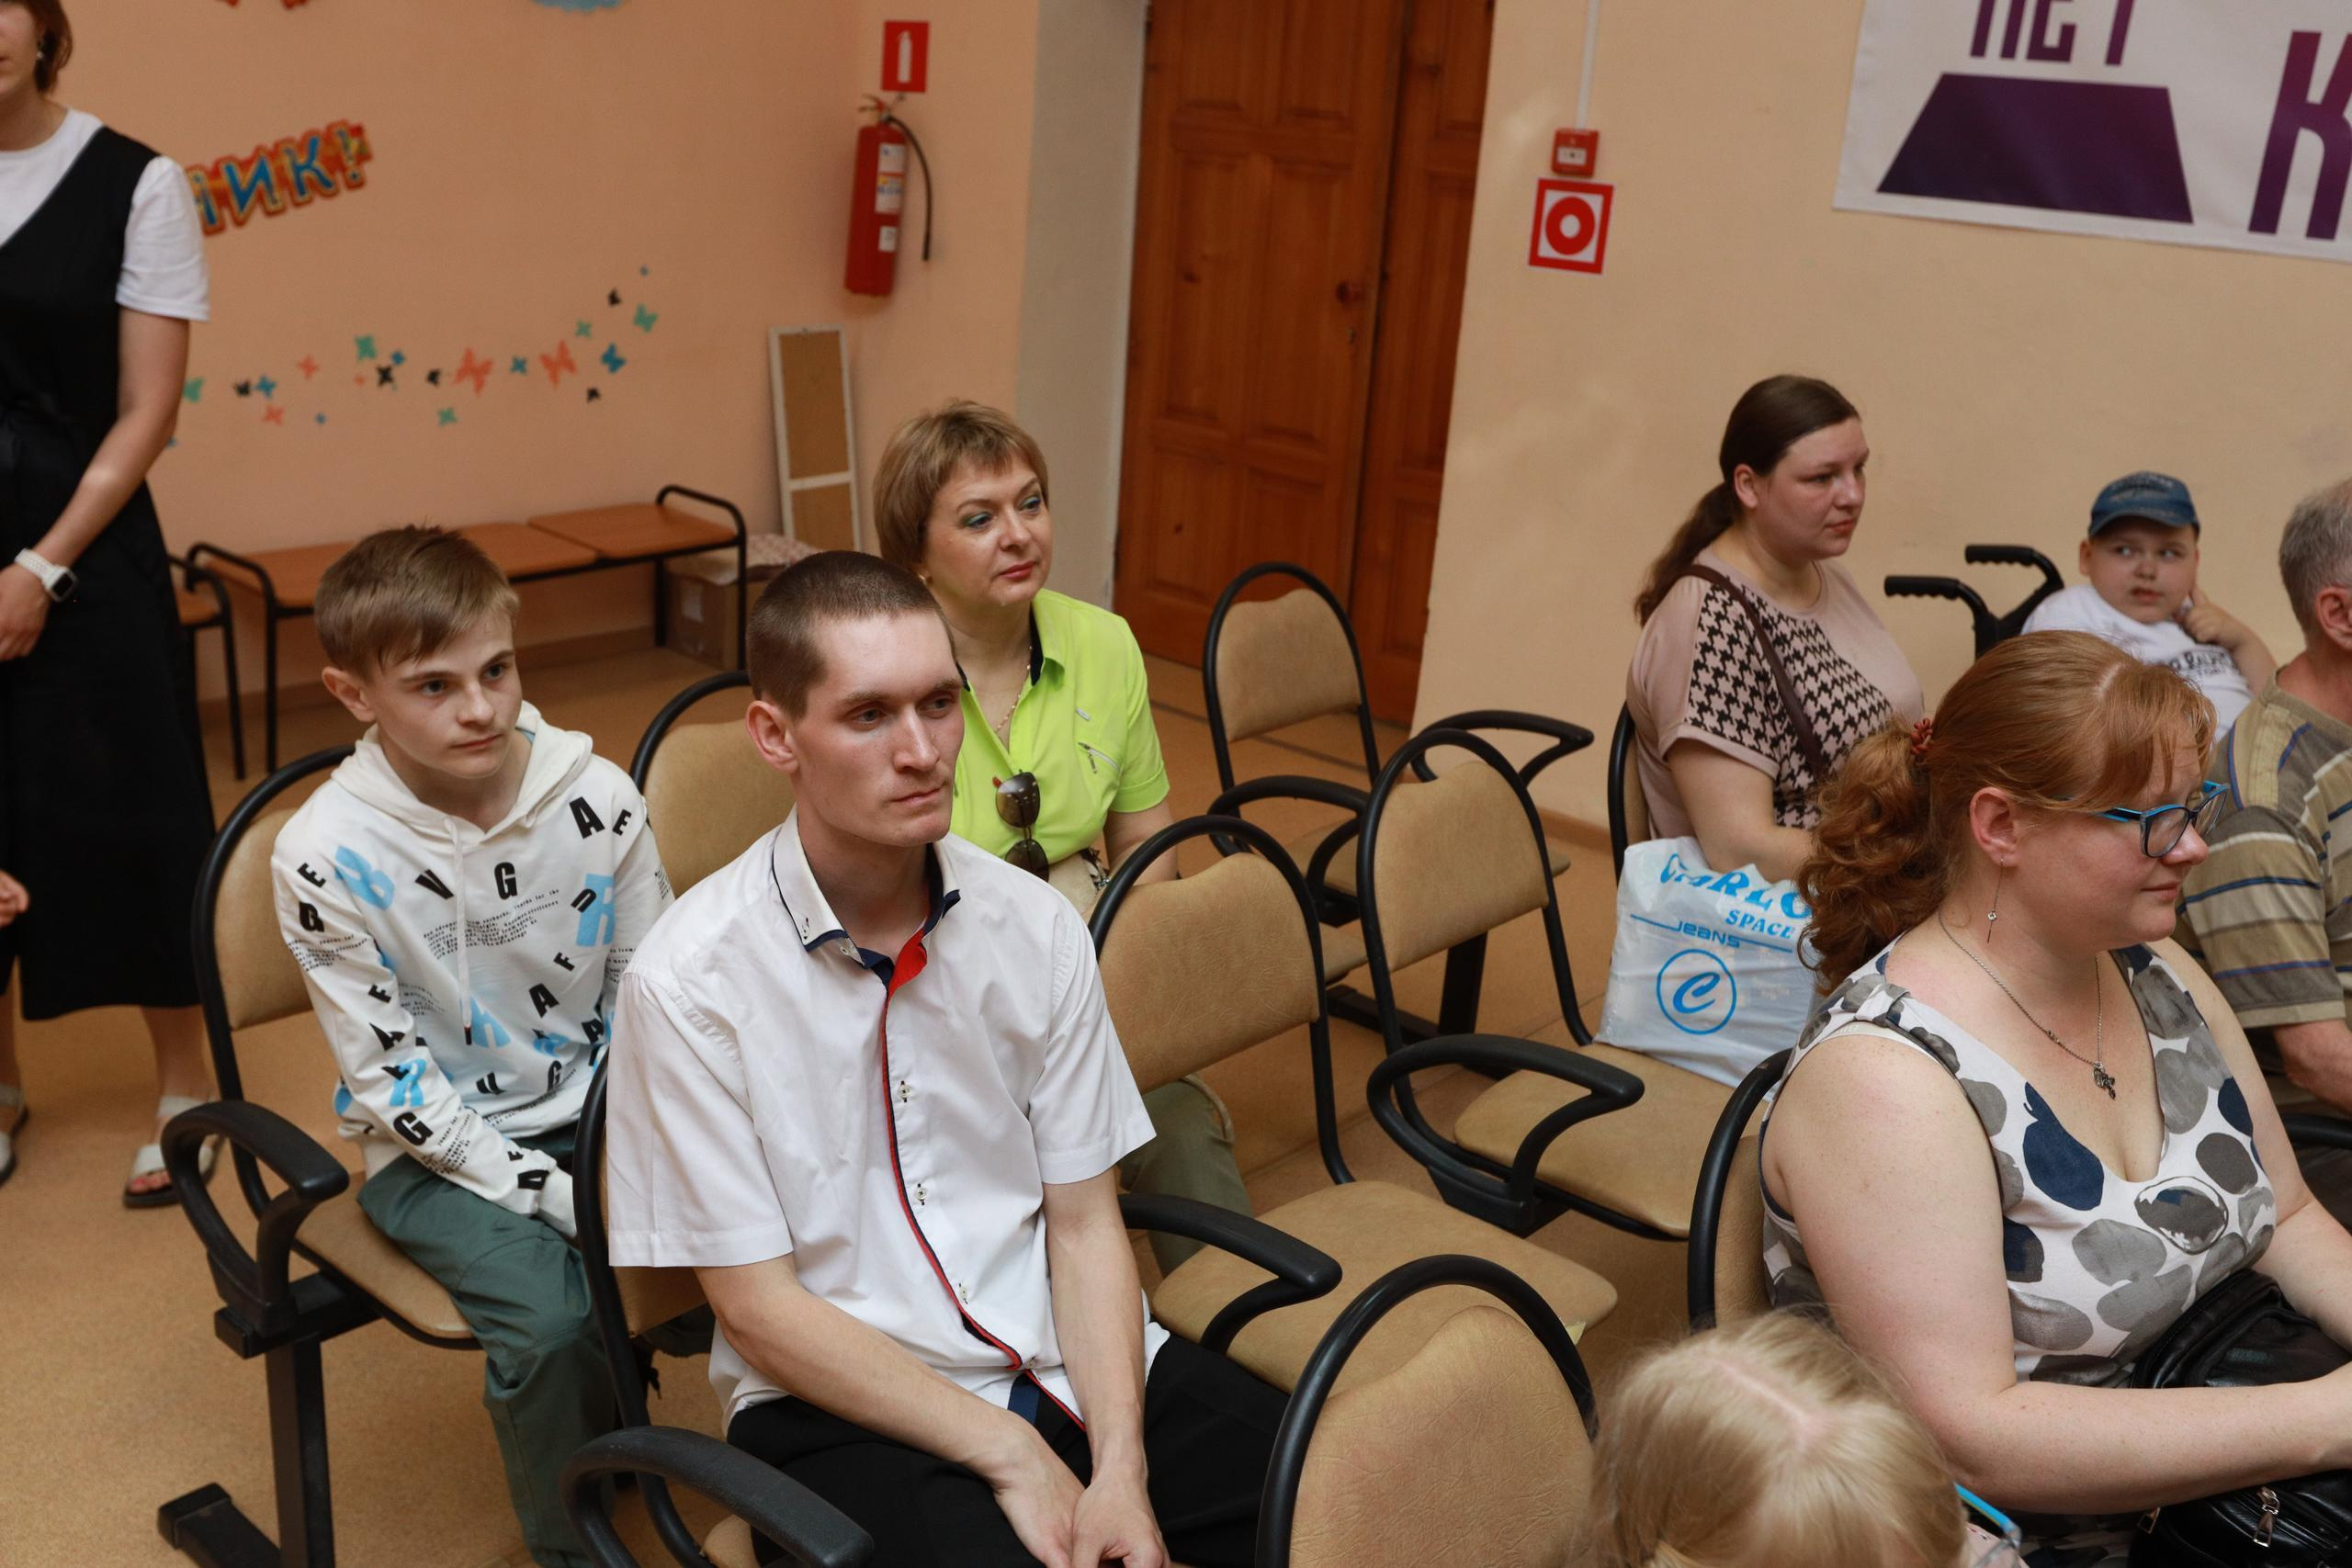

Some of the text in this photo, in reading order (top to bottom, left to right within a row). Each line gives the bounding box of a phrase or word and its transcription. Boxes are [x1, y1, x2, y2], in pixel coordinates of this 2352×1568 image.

[569, 796, 605, 840] A
[612, 808, 632, 836] E
[297, 863, 326, 888] E
[494, 862, 518, 900] G
[1725, 909, 1795, 940] SPACE
[553, 952, 575, 972] F
[368, 984, 391, 1003] F
[527, 983, 559, 1018] A
[393, 1111, 434, 1146] G
